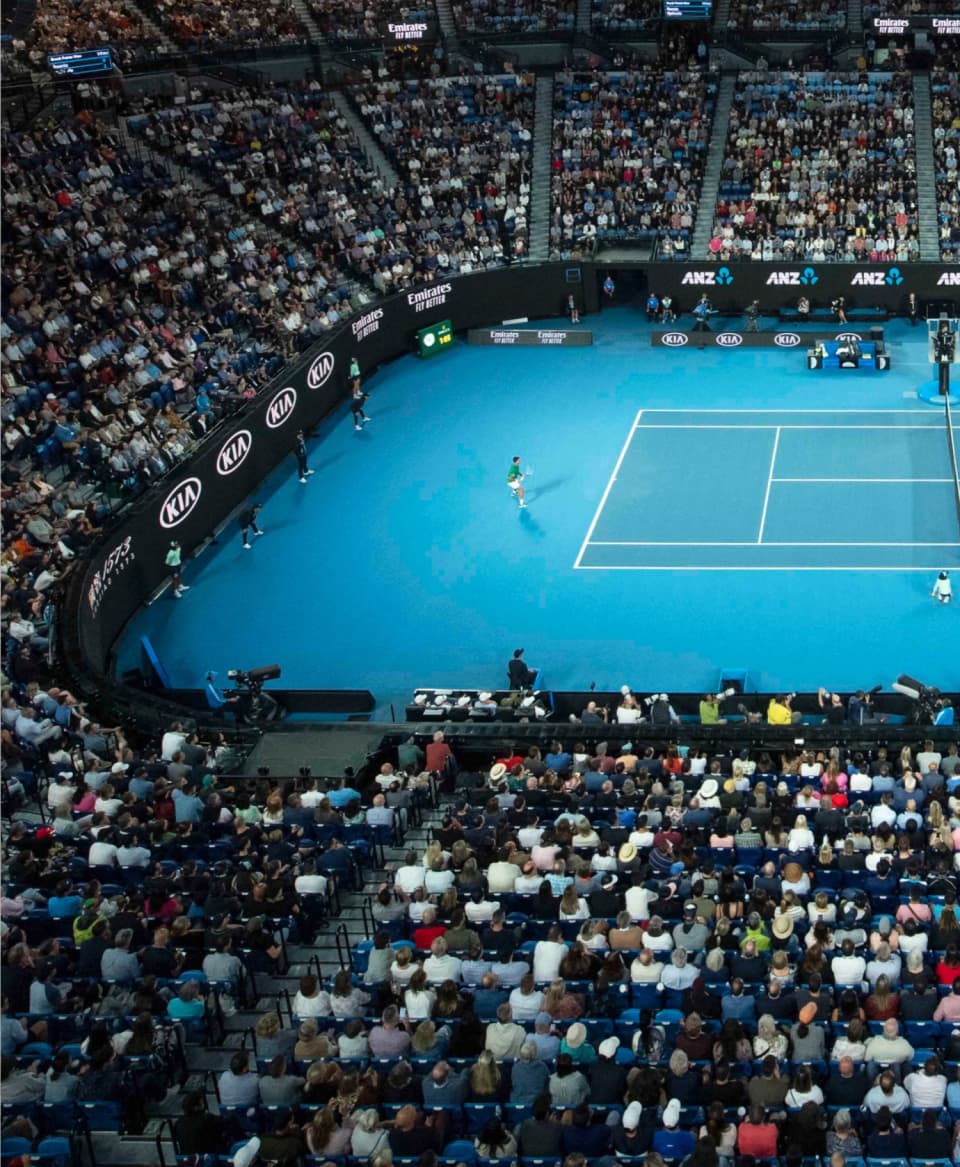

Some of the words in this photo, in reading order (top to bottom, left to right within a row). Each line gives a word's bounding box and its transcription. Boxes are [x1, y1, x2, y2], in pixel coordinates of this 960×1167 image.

[388, 23, 428, 32] Emirates
[874, 18, 909, 27] Emirates
[682, 272, 716, 285] ANZ
[766, 272, 800, 285] ANZ
[851, 272, 886, 285] ANZ
[407, 283, 452, 305] Emirates
[415, 302, 425, 312] FLY
[425, 294, 446, 309] BETTER
[352, 308, 384, 335] Emirates
[102, 536, 132, 581] 1573
